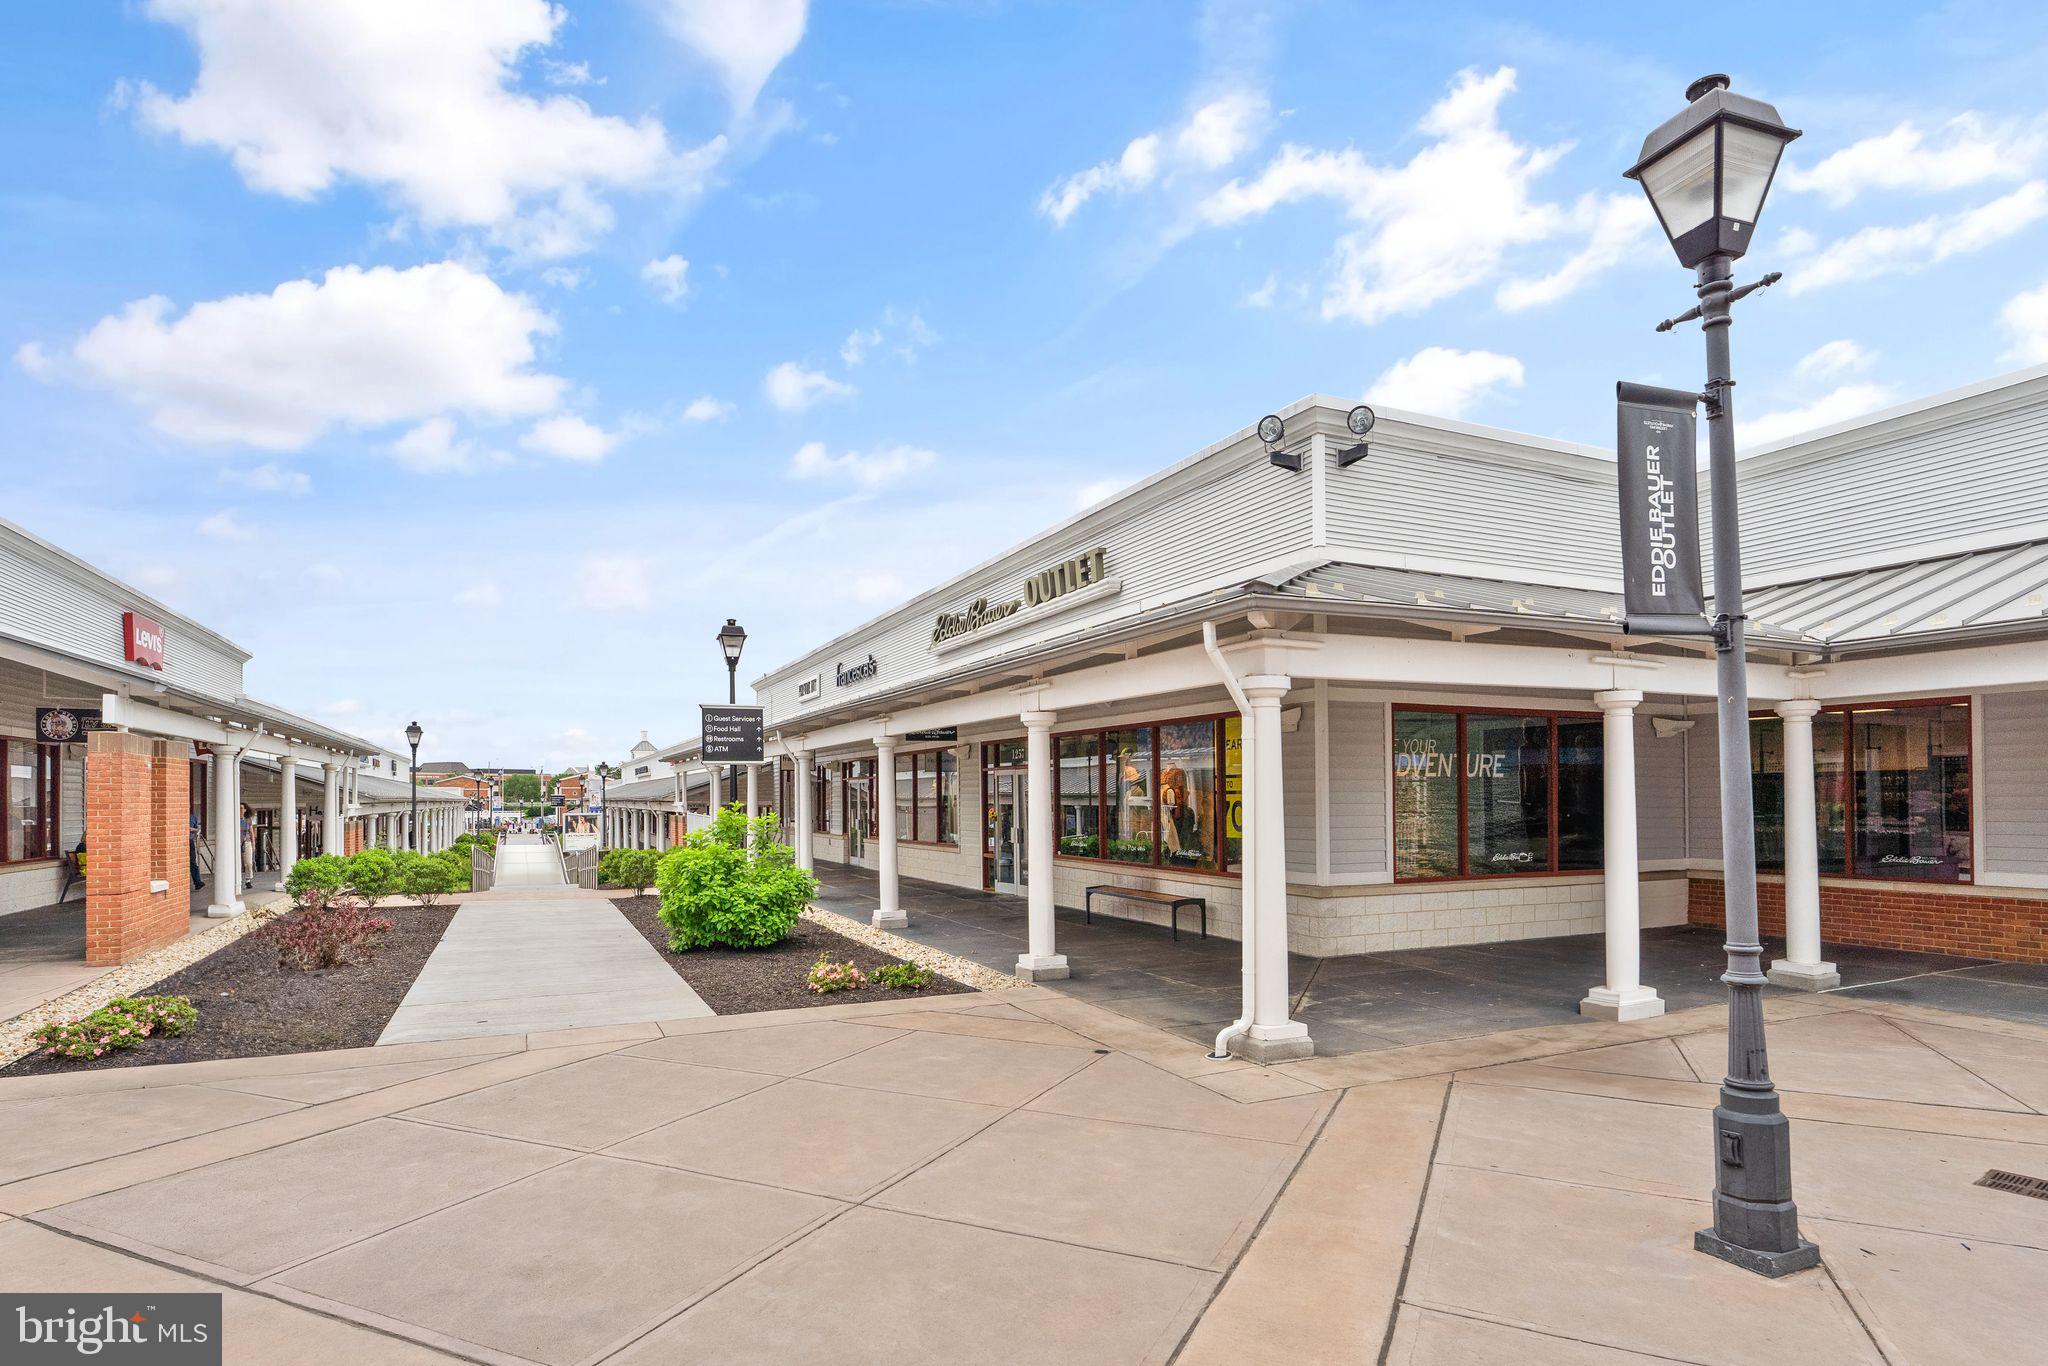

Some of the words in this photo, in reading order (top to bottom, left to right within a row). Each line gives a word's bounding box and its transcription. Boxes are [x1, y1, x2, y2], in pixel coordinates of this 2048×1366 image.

[1646, 445, 1664, 523] BAUER
[1660, 474, 1677, 570] OUTLET
[1024, 547, 1107, 608] OUTLET
[1650, 527, 1667, 597] EDDIE
[1402, 738, 1437, 754] YOUR
[1878, 854, 1909, 863] Eddie
[1908, 855, 1944, 865] Bauer
